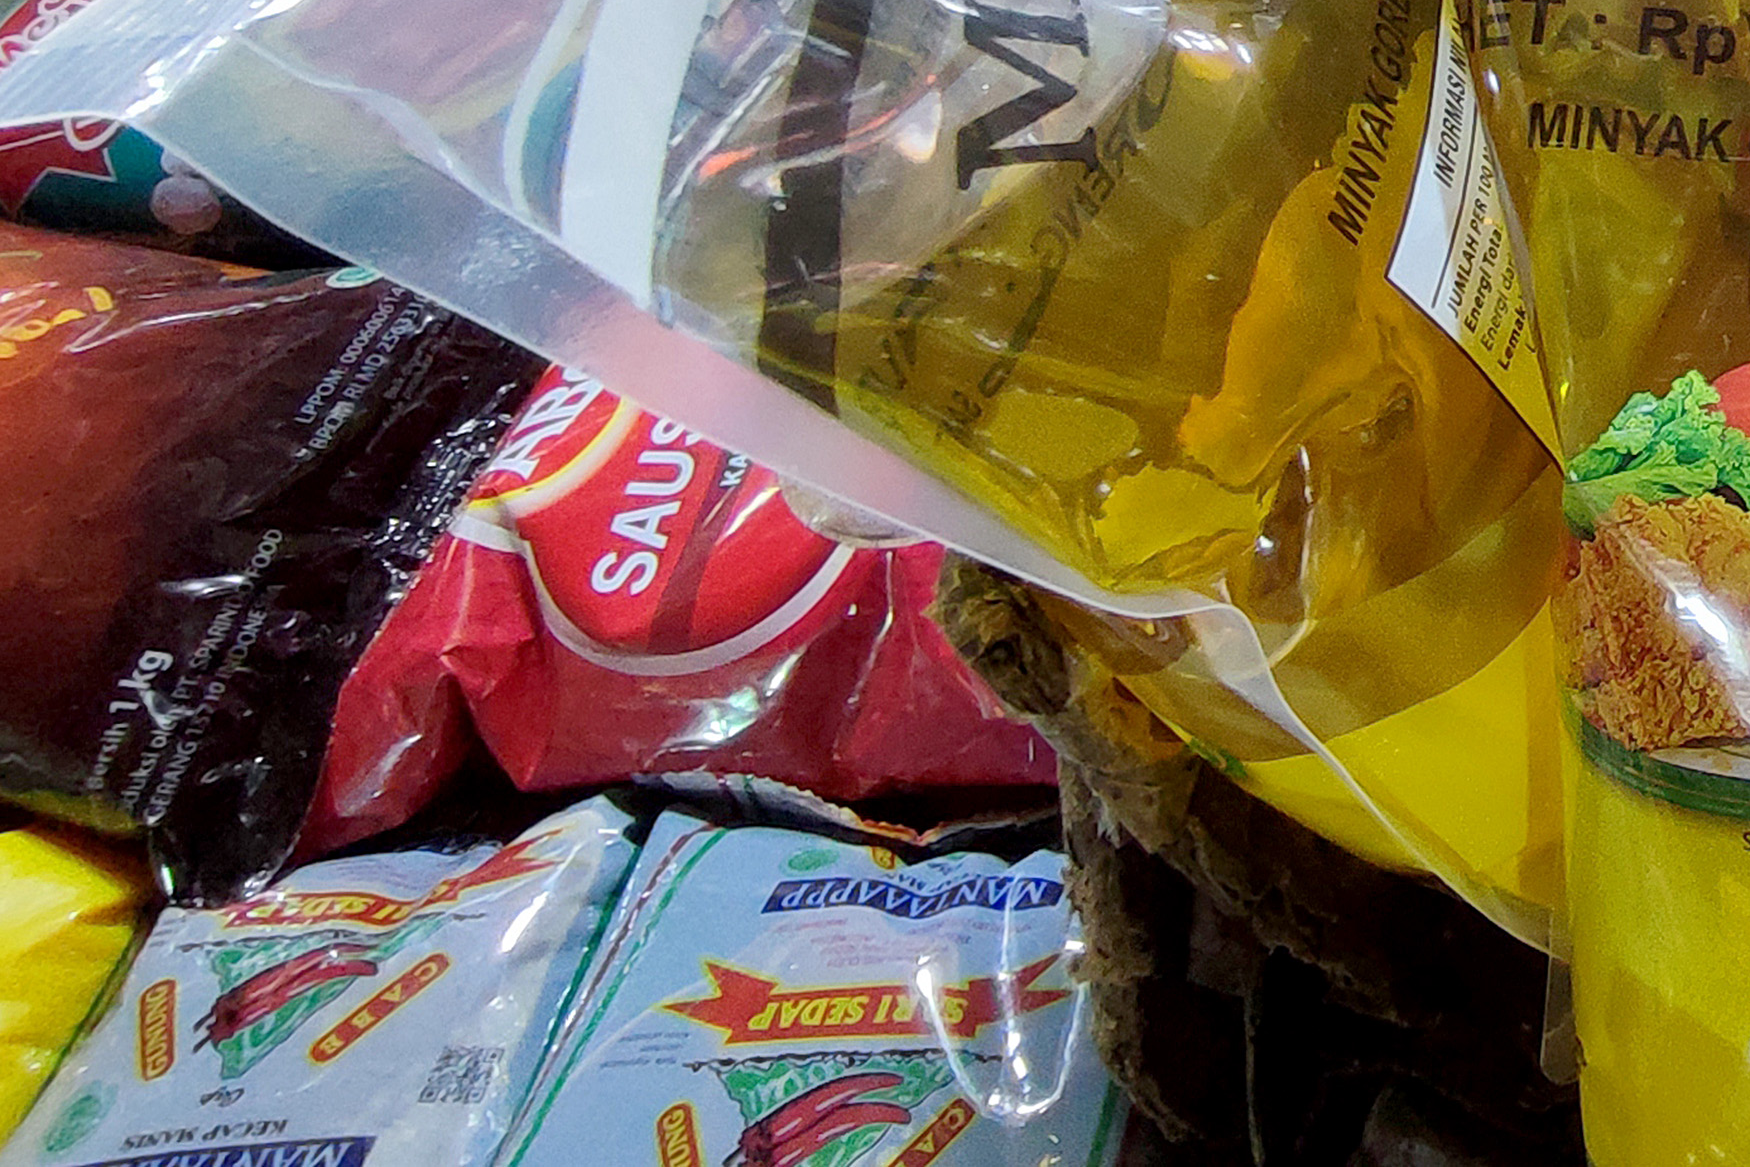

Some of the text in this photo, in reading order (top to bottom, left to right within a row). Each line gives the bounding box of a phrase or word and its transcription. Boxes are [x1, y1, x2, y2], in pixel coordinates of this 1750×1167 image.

[1638, 6, 1737, 76] Rp
[1433, 67, 1469, 189] INFORMASI
[1527, 100, 1734, 164] MINYAK
[1327, 76, 1399, 246] MINYAK
[1446, 235, 1481, 320] JUMLAH
[1469, 197, 1488, 236] PER
[1463, 272, 1497, 335] Energi
[1479, 295, 1508, 353] Energi
[355, 352, 389, 382] MD
[1497, 304, 1529, 372] Lemak
[243, 527, 284, 580] FOOD
[117, 648, 175, 692] kg
[141, 984, 174, 1079] GUNUNG
[312, 954, 448, 1062] CABE
[747, 996, 869, 1032] SEDAP
[123, 1119, 289, 1151] KECAP MANIS
